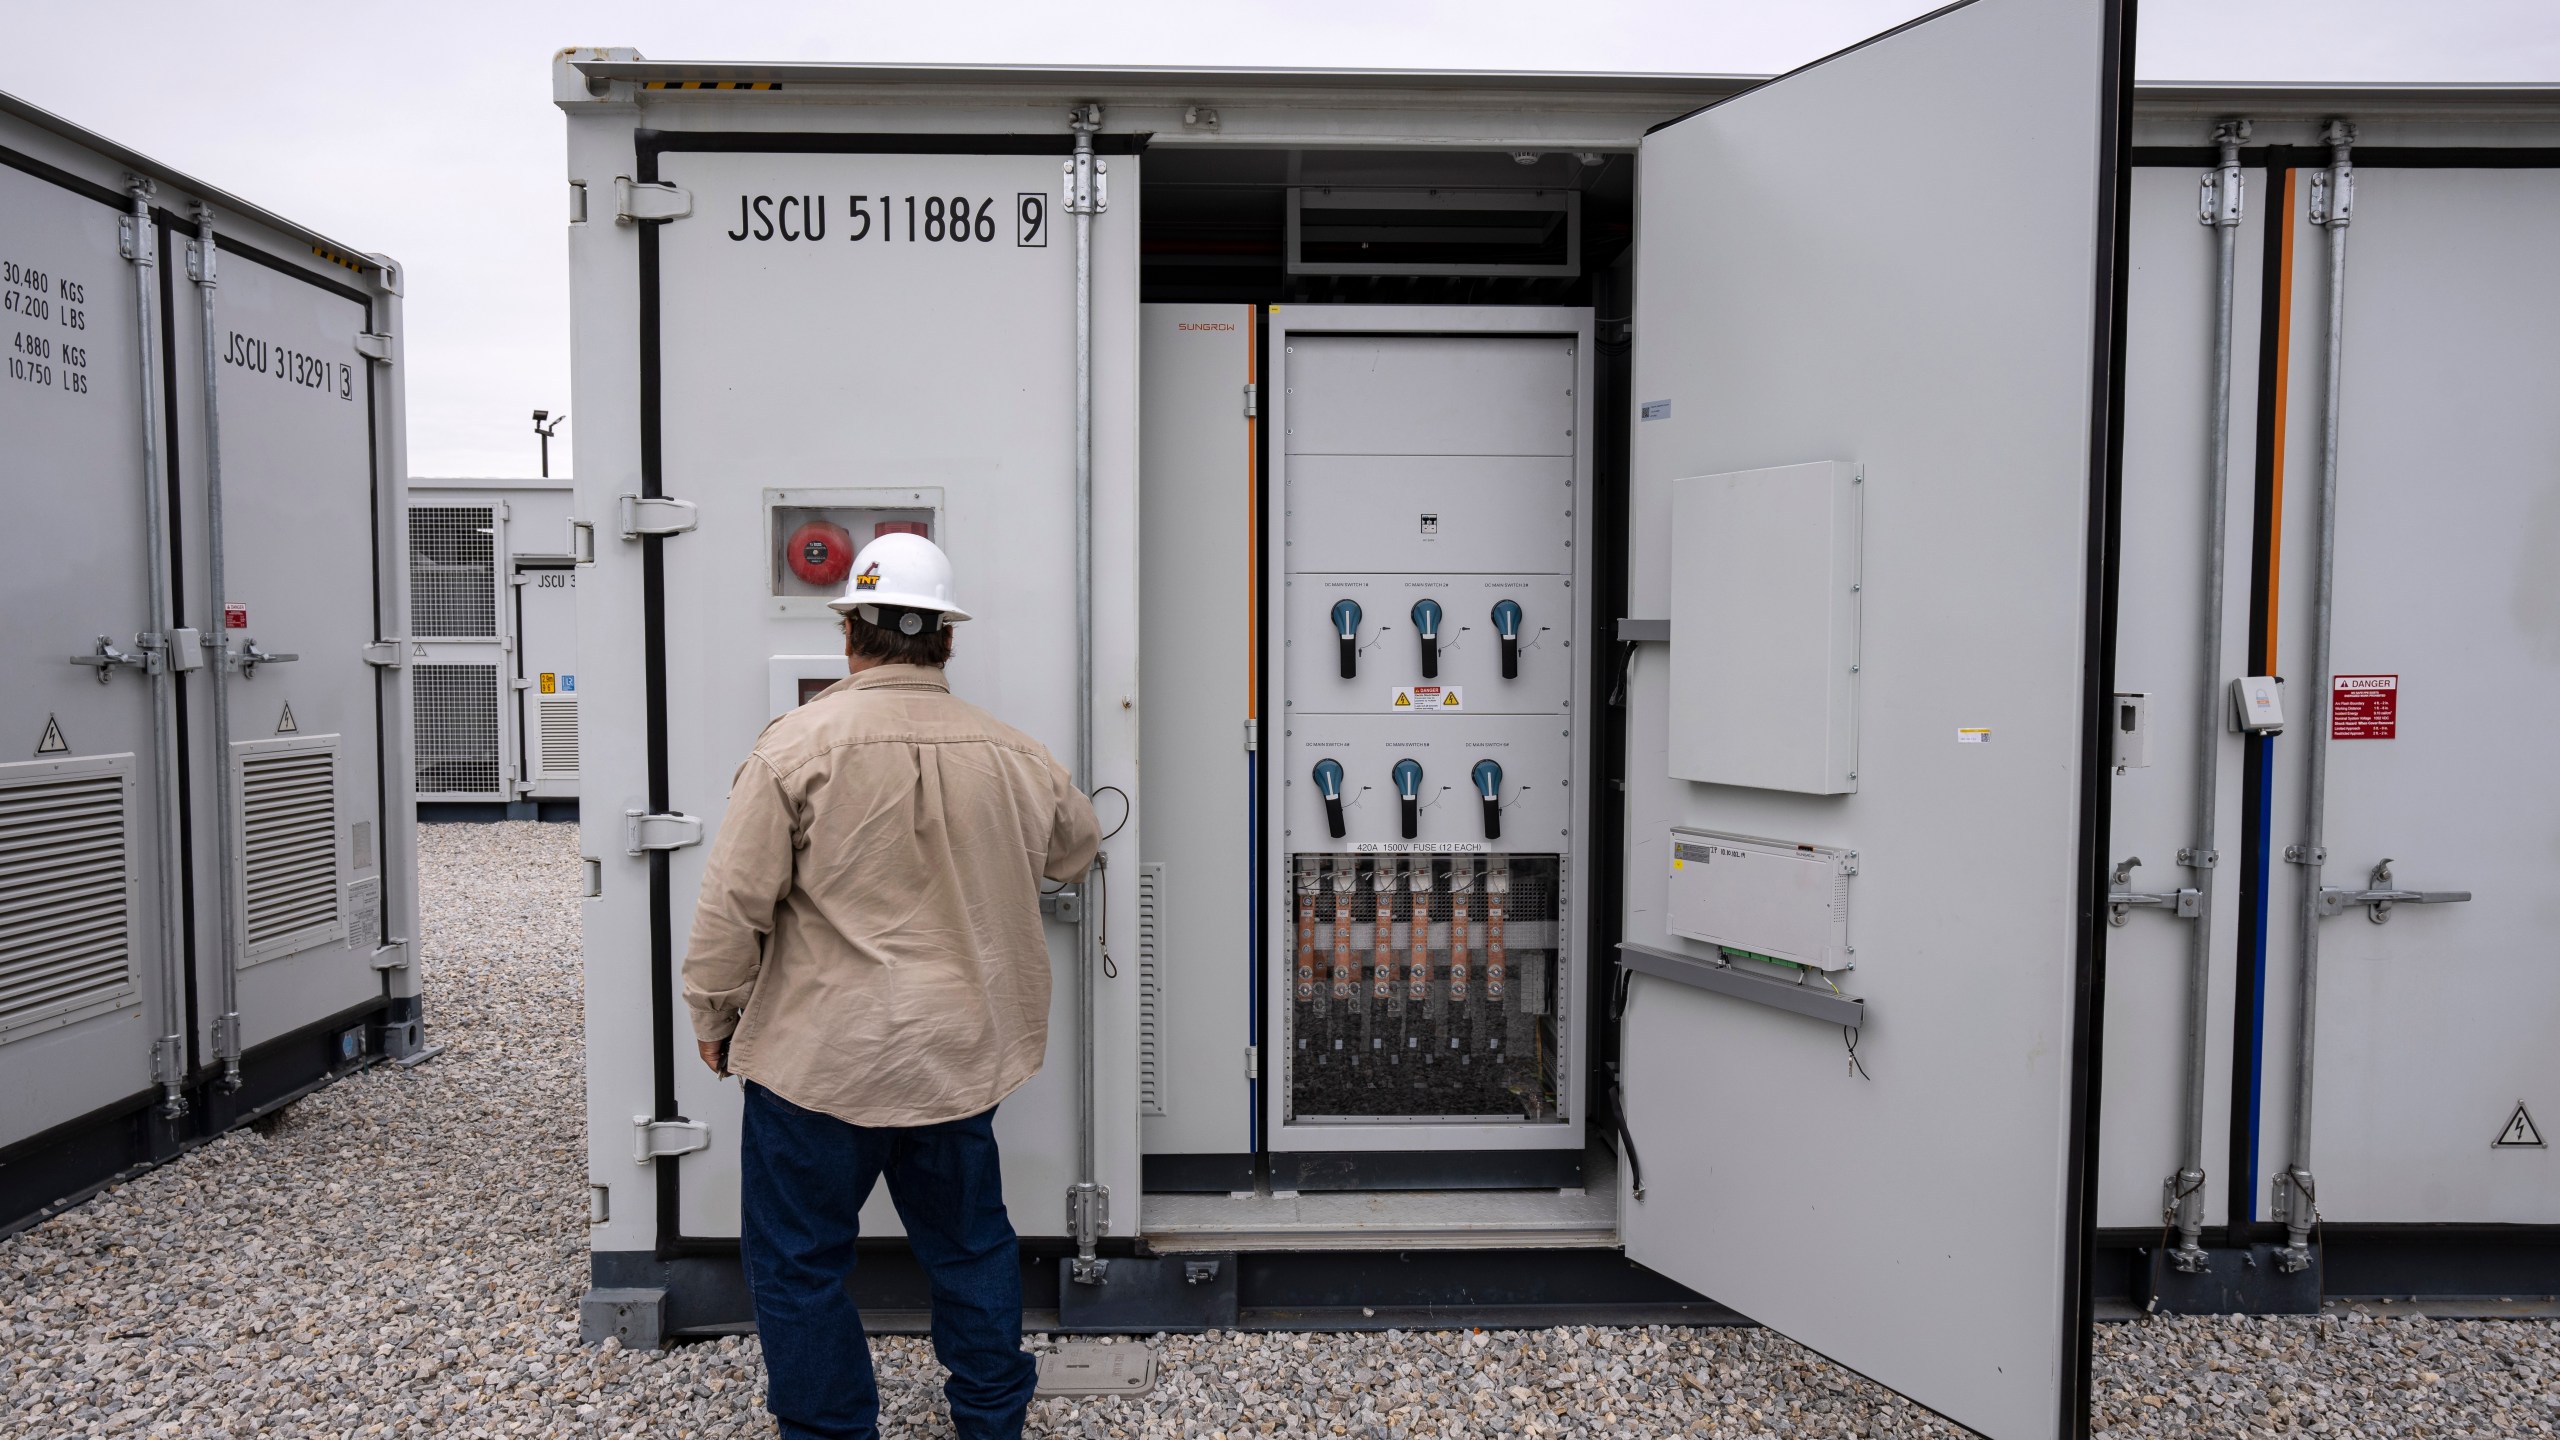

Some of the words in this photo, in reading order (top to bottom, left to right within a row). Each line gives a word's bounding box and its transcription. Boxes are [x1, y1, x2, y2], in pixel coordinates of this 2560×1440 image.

[728, 195, 826, 242] JSCU
[850, 195, 995, 242] 511886
[1021, 196, 1043, 243] 9
[3, 261, 48, 294] 30.480
[60, 278, 85, 304] KGS
[4, 291, 50, 320] 67.200
[61, 305, 86, 331] LBS
[1178, 323, 1235, 331] SUNGROW
[14, 332, 50, 359] 4.880
[62, 344, 87, 368] KGS
[224, 331, 267, 374] JSCU
[275, 347, 331, 392] 313291
[341, 367, 351, 398] 3
[8, 357, 52, 386] 10.750
[64, 372, 88, 394] LBS
[538, 575, 564, 588] JSCU
[856, 576, 880, 585] TNT
[2352, 680, 2390, 688] DANGER
